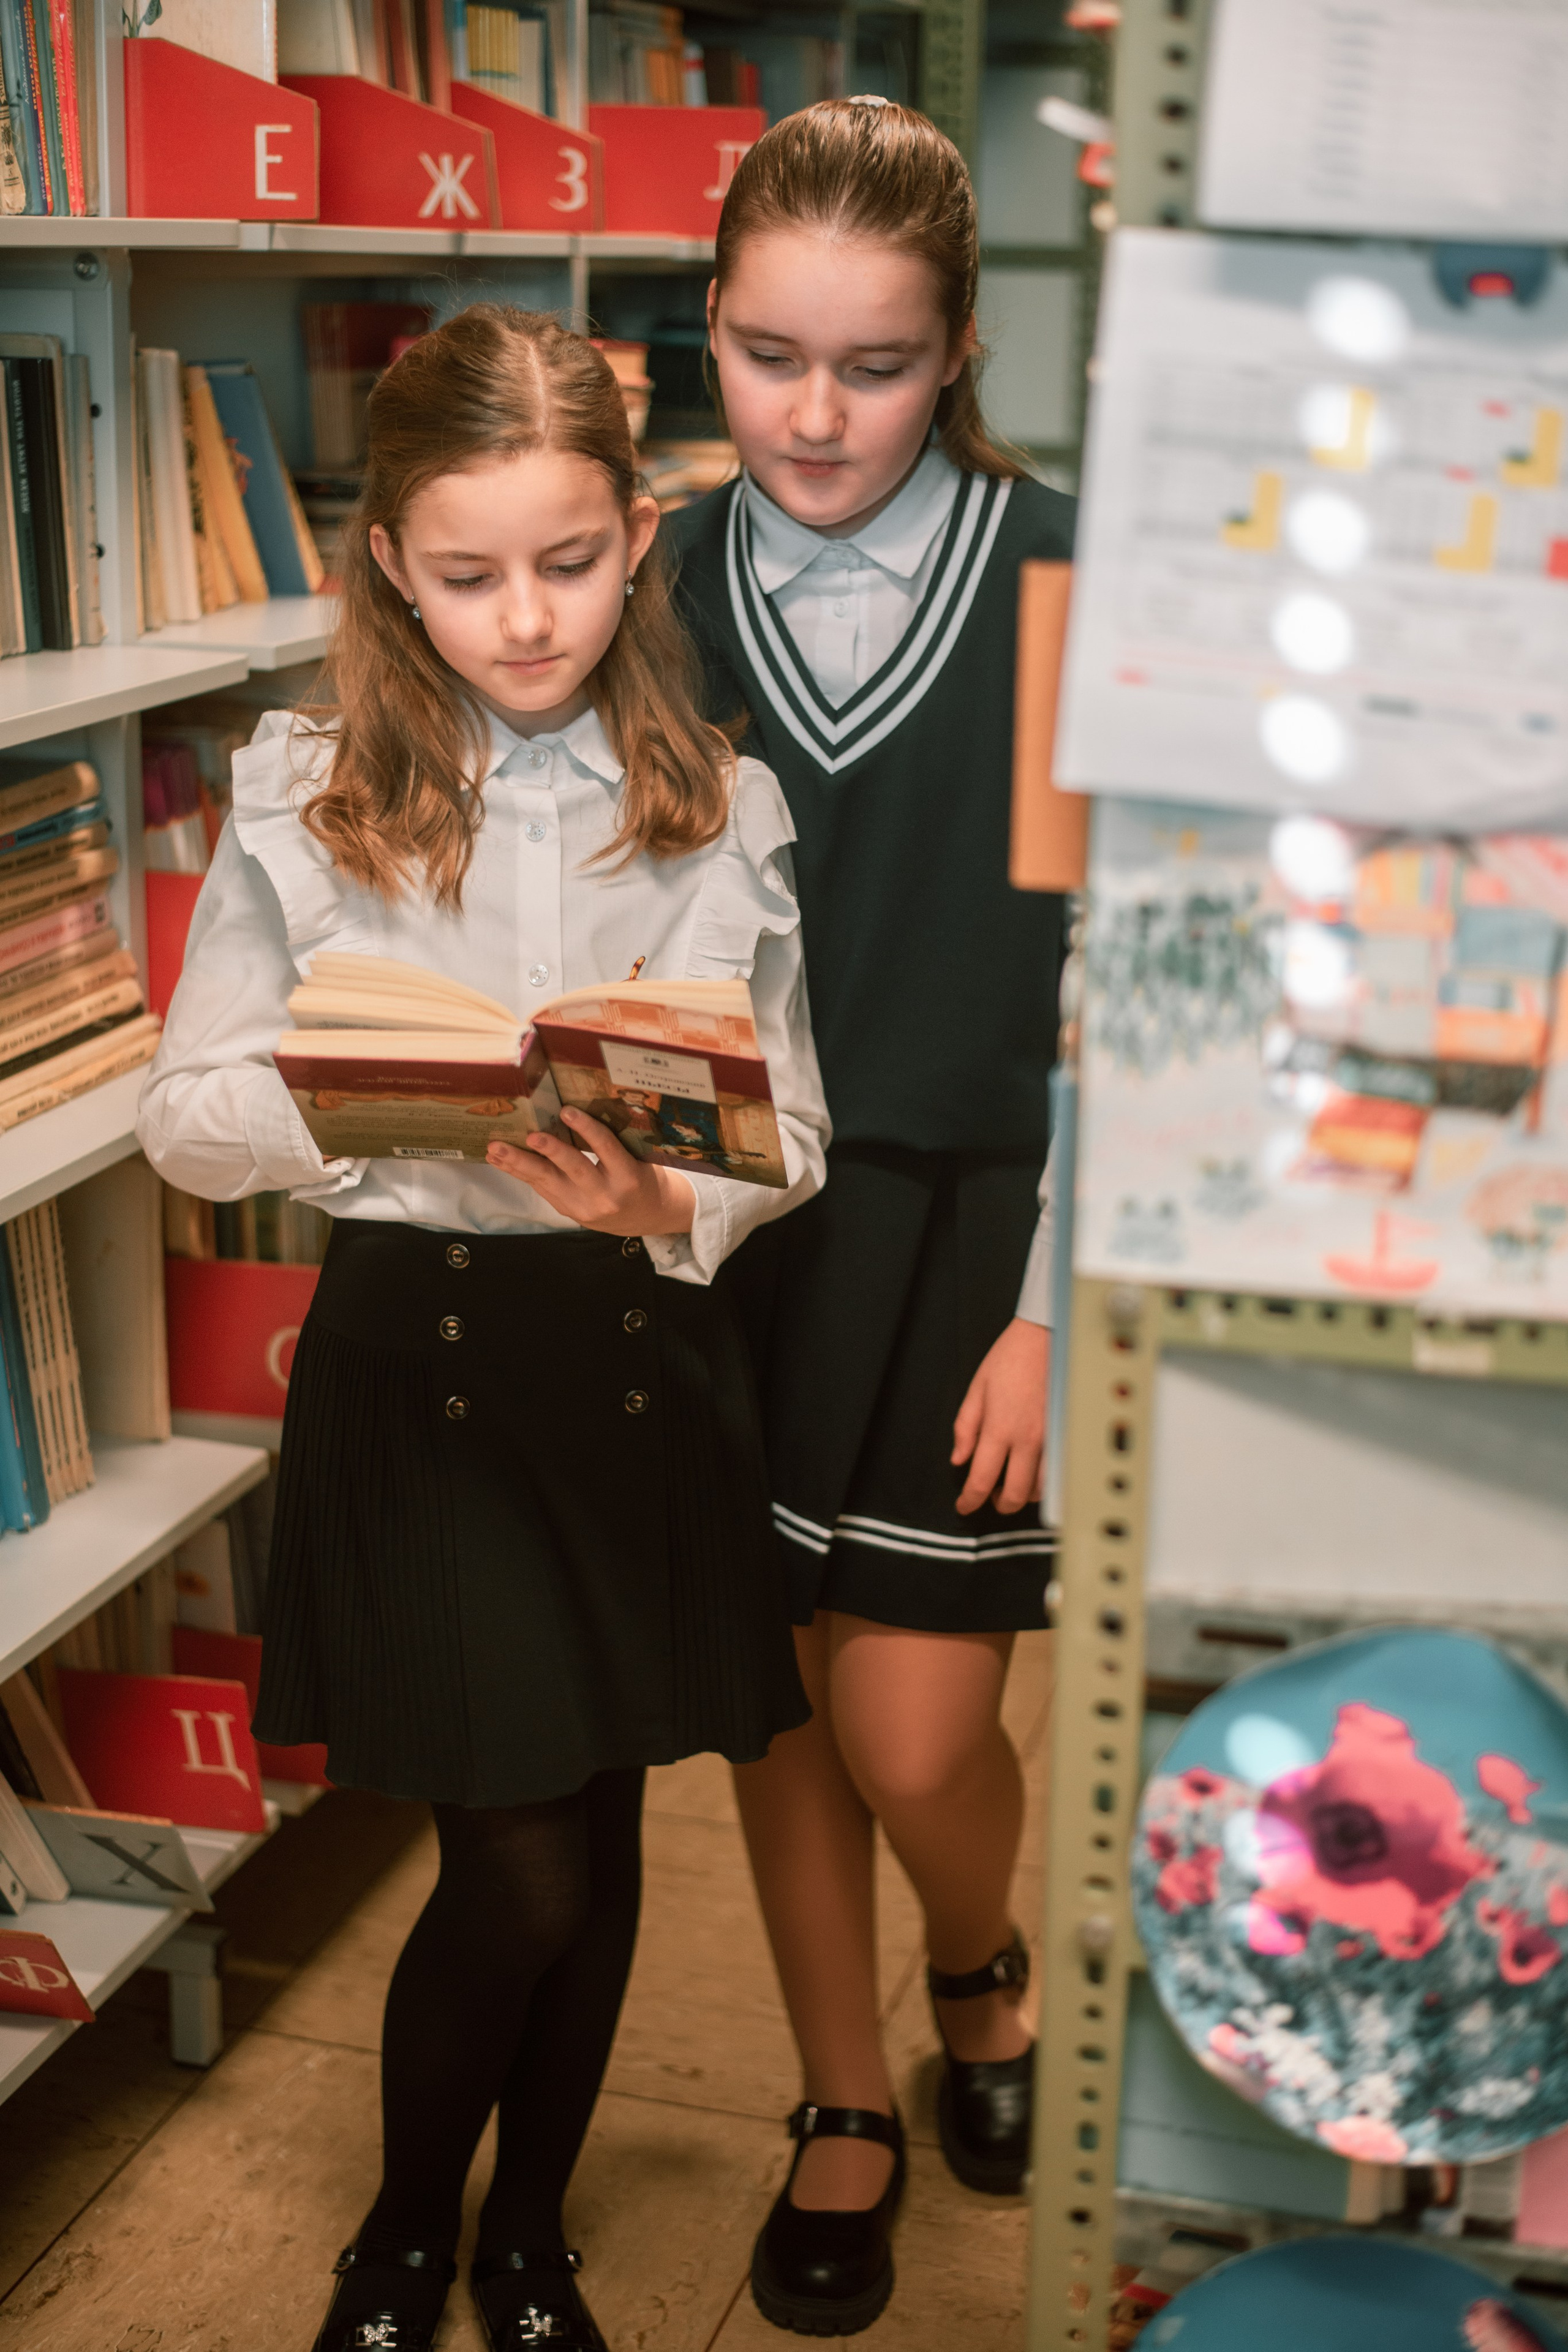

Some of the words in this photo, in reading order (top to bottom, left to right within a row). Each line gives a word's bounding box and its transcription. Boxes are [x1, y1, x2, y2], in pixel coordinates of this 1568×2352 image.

[255, 125, 298, 200] Е
[418, 152, 481, 219] Ж
[171, 1709, 252, 1792] Ц
[79, 1833, 192, 1894] Х
[0, 1956, 69, 1993] Ф
